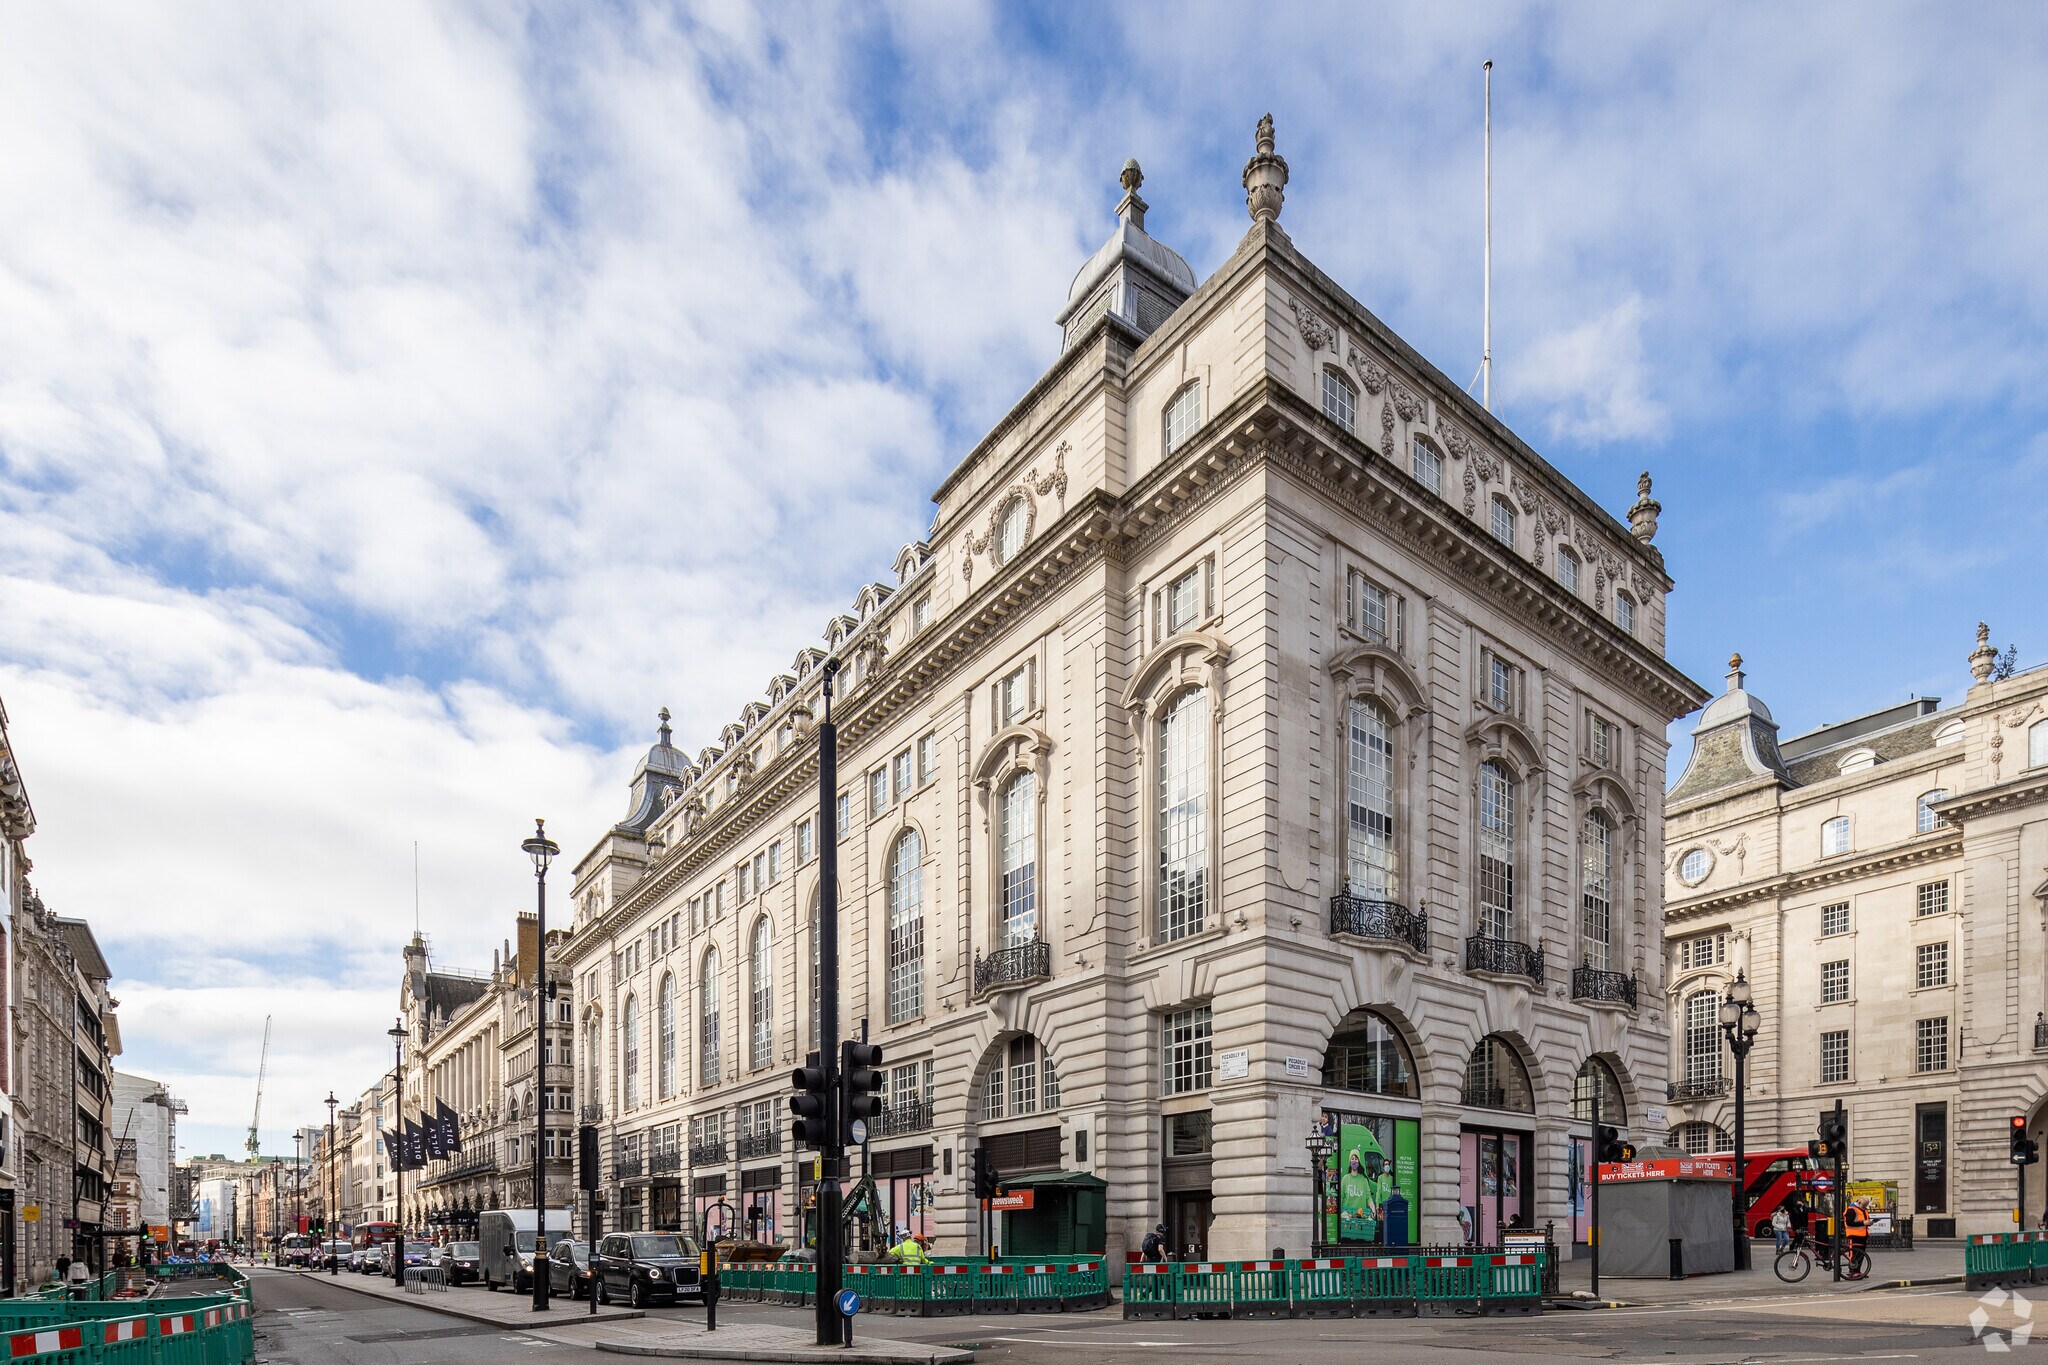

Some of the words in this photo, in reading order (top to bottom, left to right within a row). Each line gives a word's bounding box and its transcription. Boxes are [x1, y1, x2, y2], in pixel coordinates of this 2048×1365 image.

[443, 1116, 454, 1144] DILLY
[413, 1132, 422, 1159] DILLY
[429, 1128, 441, 1155] DILLY
[1926, 1144, 1938, 1152] 52
[1347, 1184, 1364, 1196] Felix
[993, 1195, 1024, 1205] Newsweek
